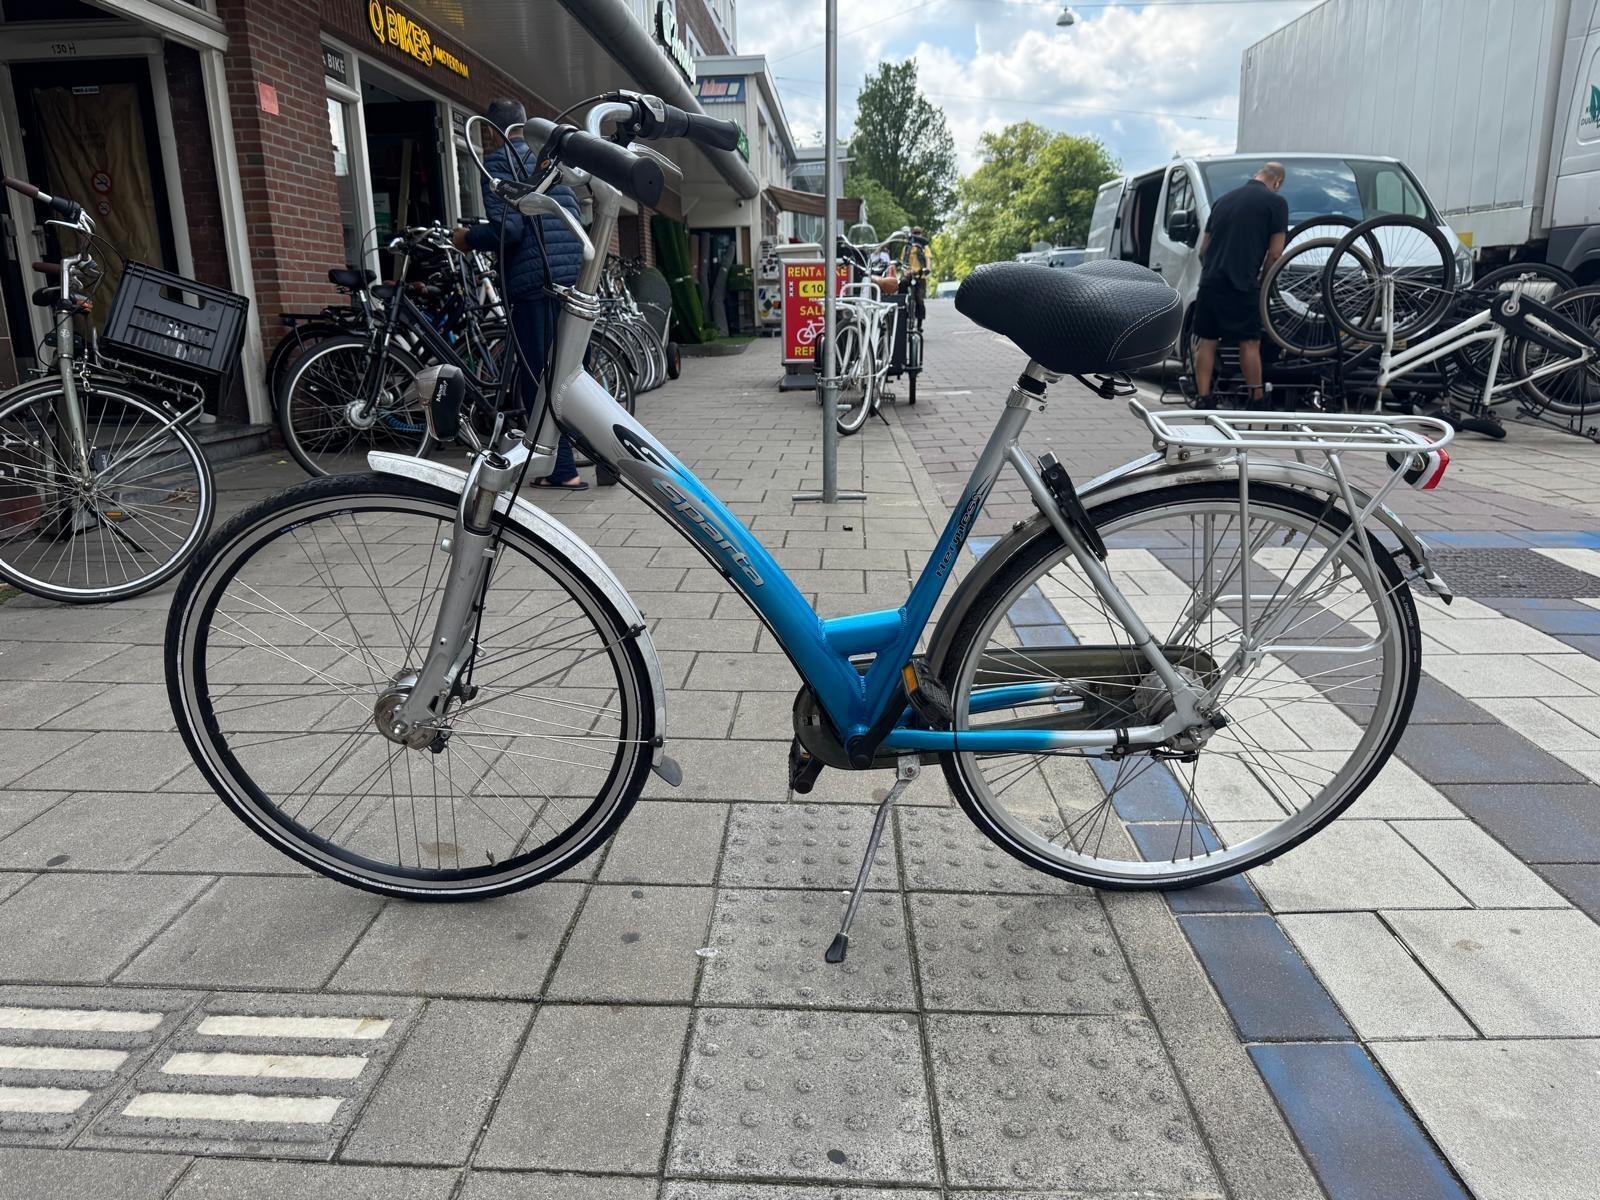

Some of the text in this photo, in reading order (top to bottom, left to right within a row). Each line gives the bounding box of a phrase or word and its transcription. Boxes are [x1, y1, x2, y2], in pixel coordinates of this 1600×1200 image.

[369, 0, 470, 79] Q BIKES AMSTERDAM
[327, 52, 346, 74] BIKE
[787, 266, 816, 278] RENT
[802, 284, 809, 294] €
